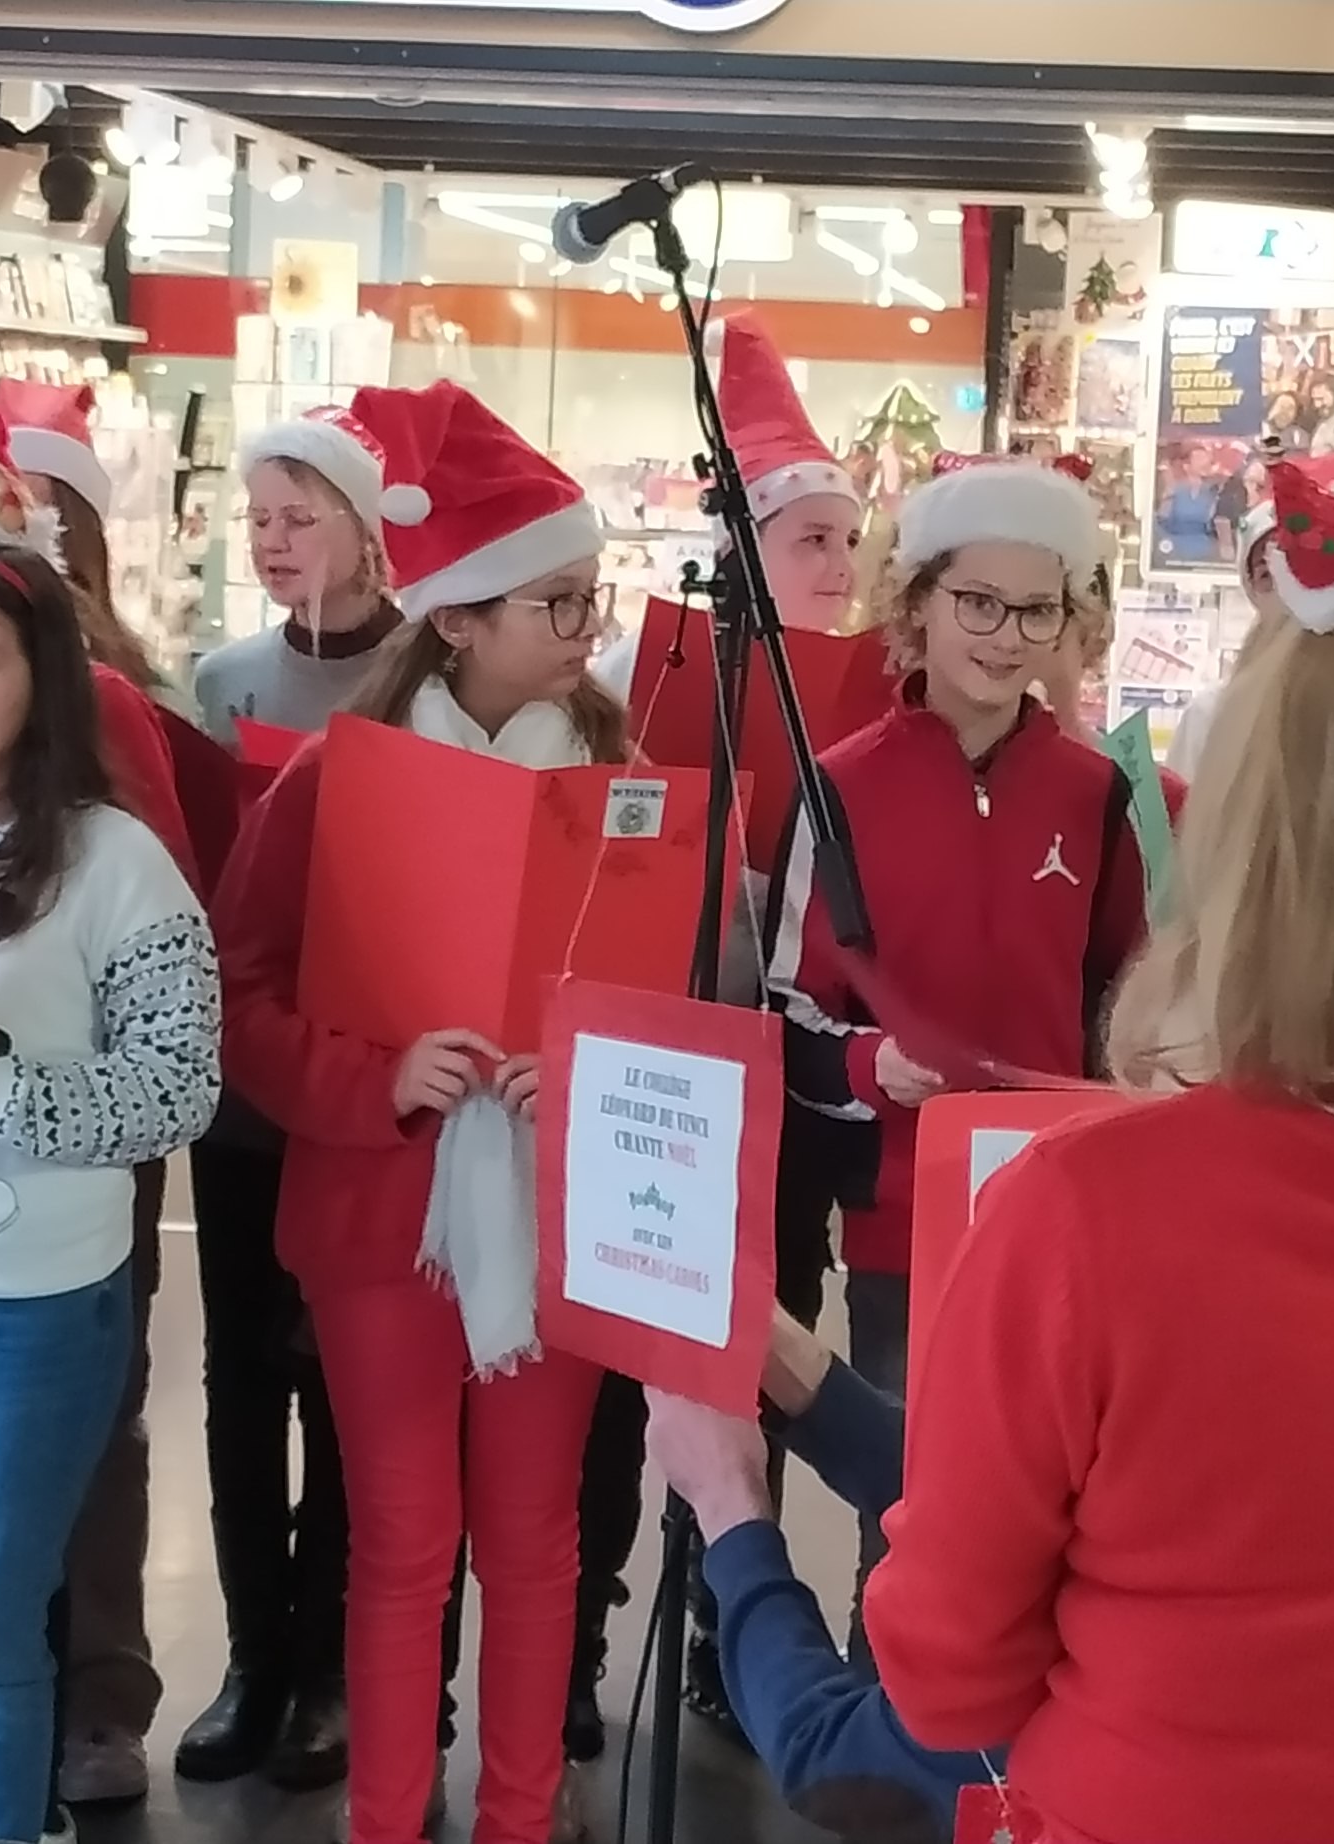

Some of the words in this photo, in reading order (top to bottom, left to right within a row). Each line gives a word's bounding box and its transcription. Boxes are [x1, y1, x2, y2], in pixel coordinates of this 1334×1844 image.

[624, 1066, 641, 1088] LE
[659, 1107, 675, 1130] DE
[614, 1129, 665, 1160] CHANTE
[594, 1241, 666, 1280] CHRISTMAS
